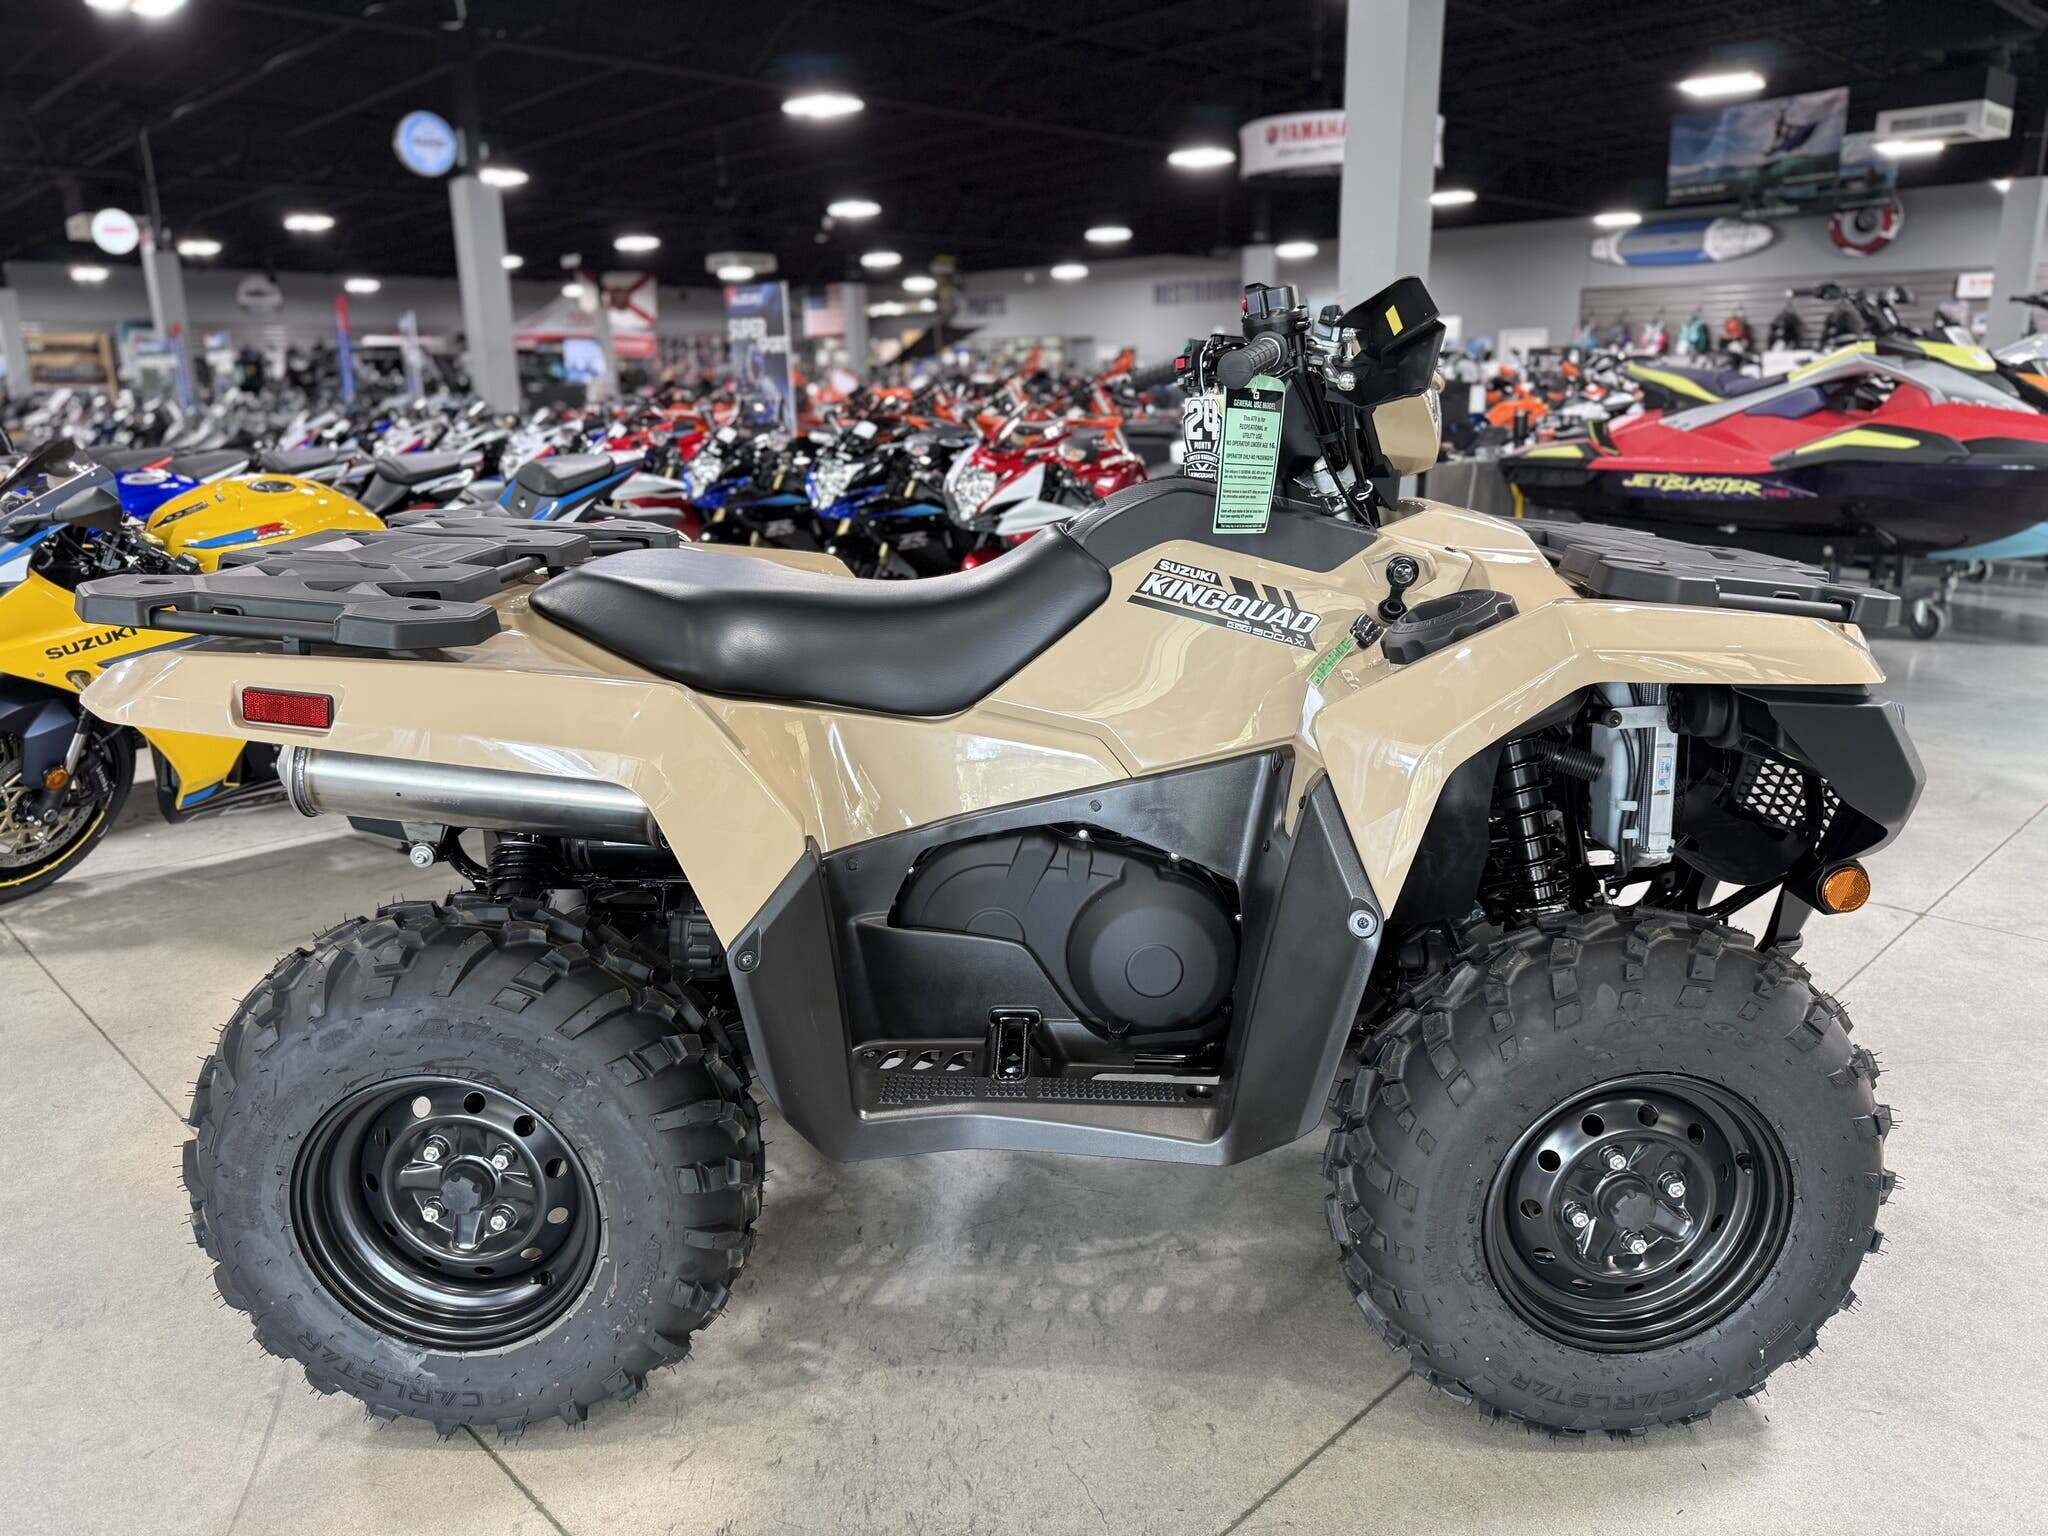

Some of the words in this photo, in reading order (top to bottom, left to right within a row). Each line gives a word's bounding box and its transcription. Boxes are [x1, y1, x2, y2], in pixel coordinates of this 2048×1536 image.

[1233, 399, 1253, 408] GENERAL
[1253, 400, 1263, 409] USE
[1263, 401, 1277, 410] MODEL
[1253, 391, 1260, 400] G
[1186, 399, 1220, 440] 24
[1193, 441, 1212, 450] MONTH
[1159, 560, 1217, 584] SUZUKI
[1140, 573, 1321, 634] KINGQUAD
[45, 626, 138, 660] SUZUKI
